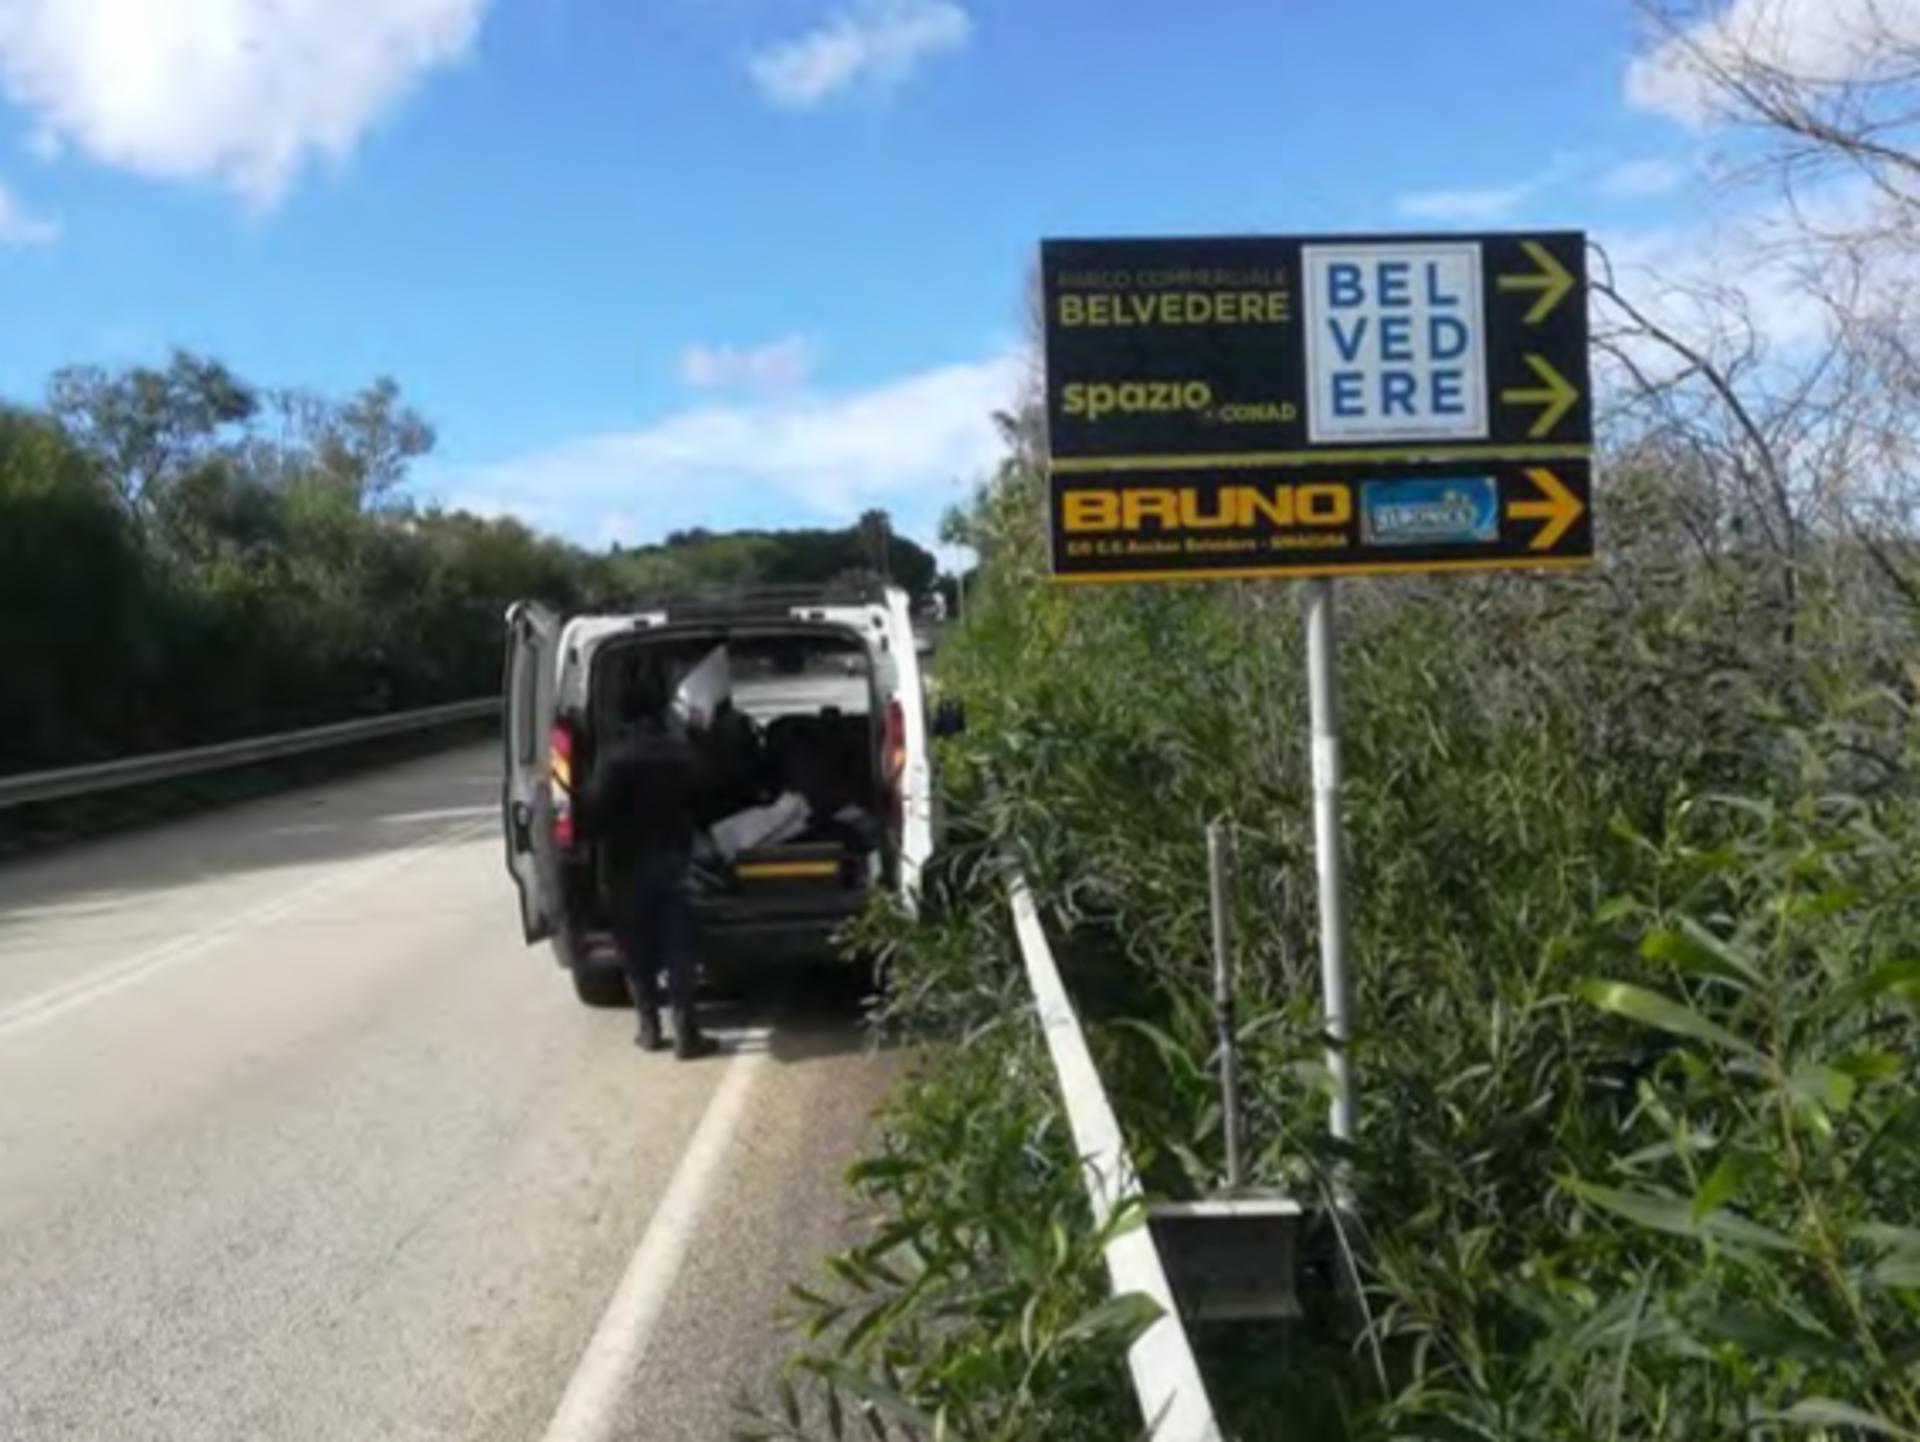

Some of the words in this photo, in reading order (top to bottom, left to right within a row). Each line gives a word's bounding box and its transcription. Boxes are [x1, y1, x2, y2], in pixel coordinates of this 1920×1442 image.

[1060, 291, 1291, 326] BELVEDERE
[1327, 261, 1459, 309] BEL
[1327, 315, 1469, 363] VED
[1062, 380, 1213, 420] spazio
[1331, 369, 1466, 417] ERE
[1063, 482, 1351, 531] BRUNO
